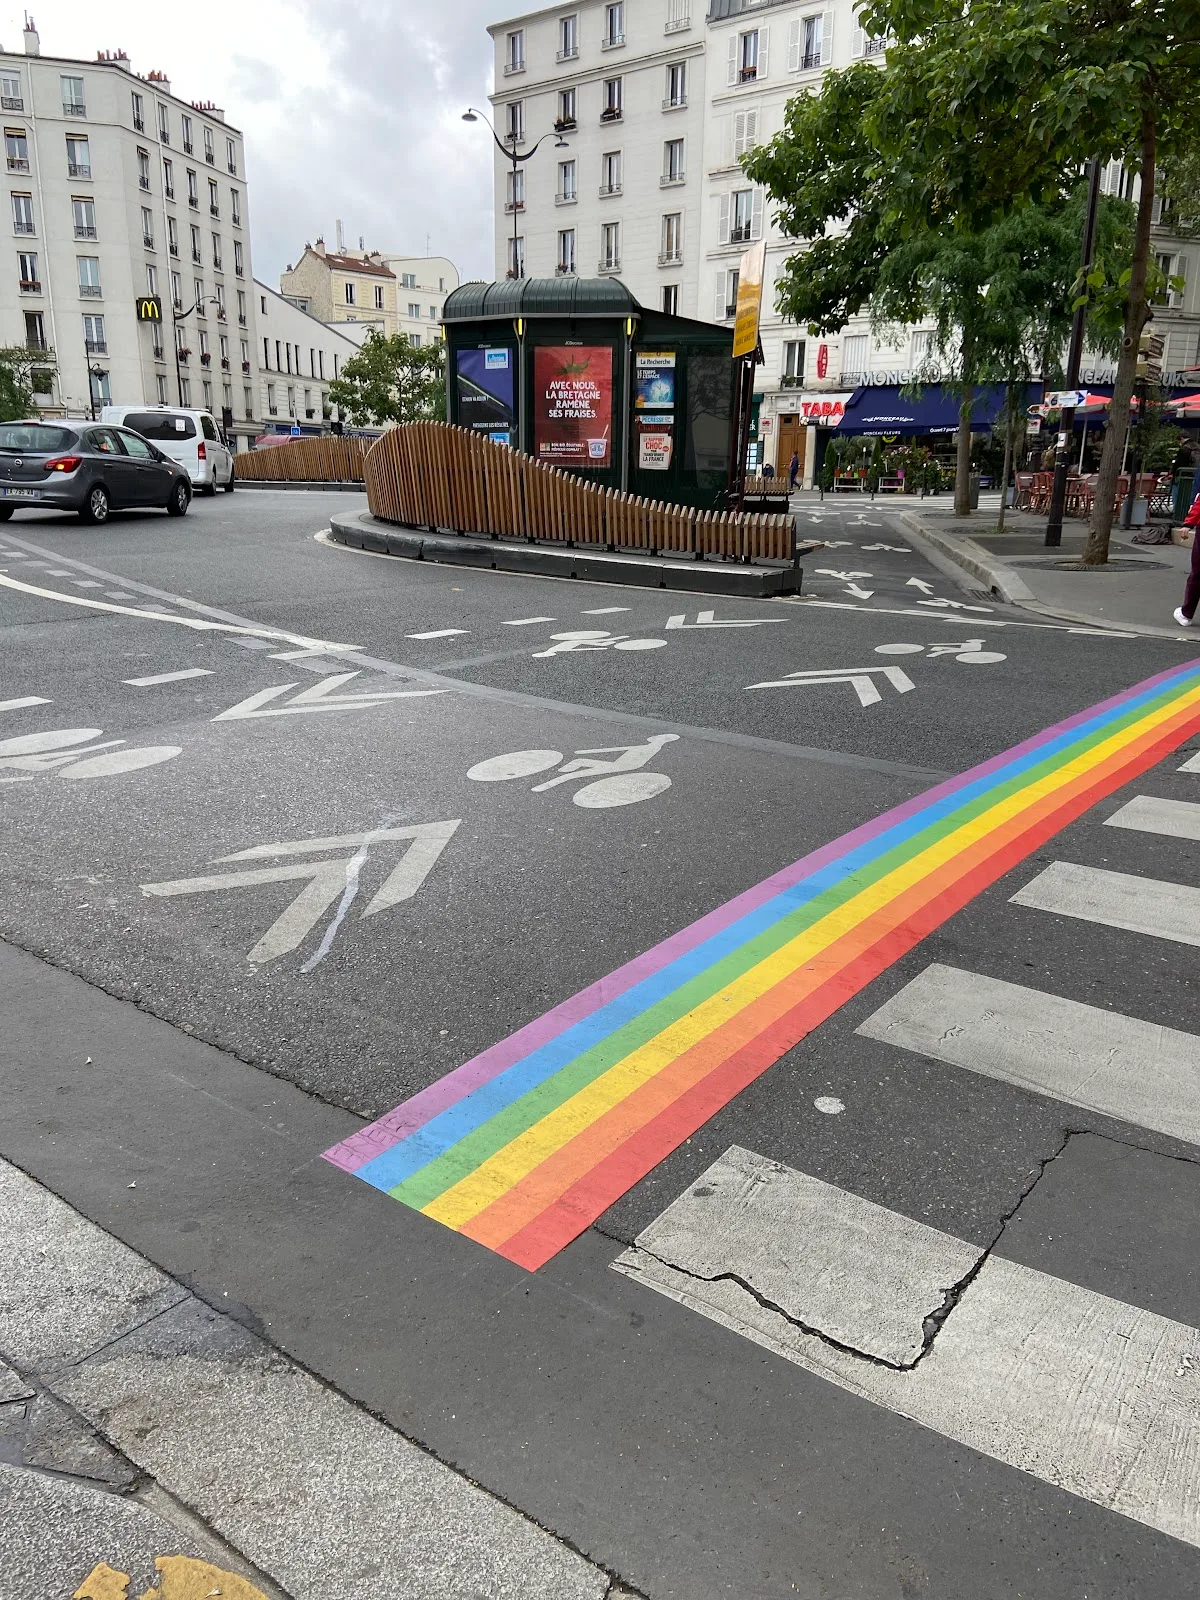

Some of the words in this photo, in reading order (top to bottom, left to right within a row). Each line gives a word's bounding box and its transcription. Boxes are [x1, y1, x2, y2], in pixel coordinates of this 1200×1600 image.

[550, 381, 571, 389] AVEC
[545, 391, 557, 399] LA
[558, 391, 601, 399] BRETAGNE
[801, 402, 846, 417] TABA
[548, 410, 563, 418] SES
